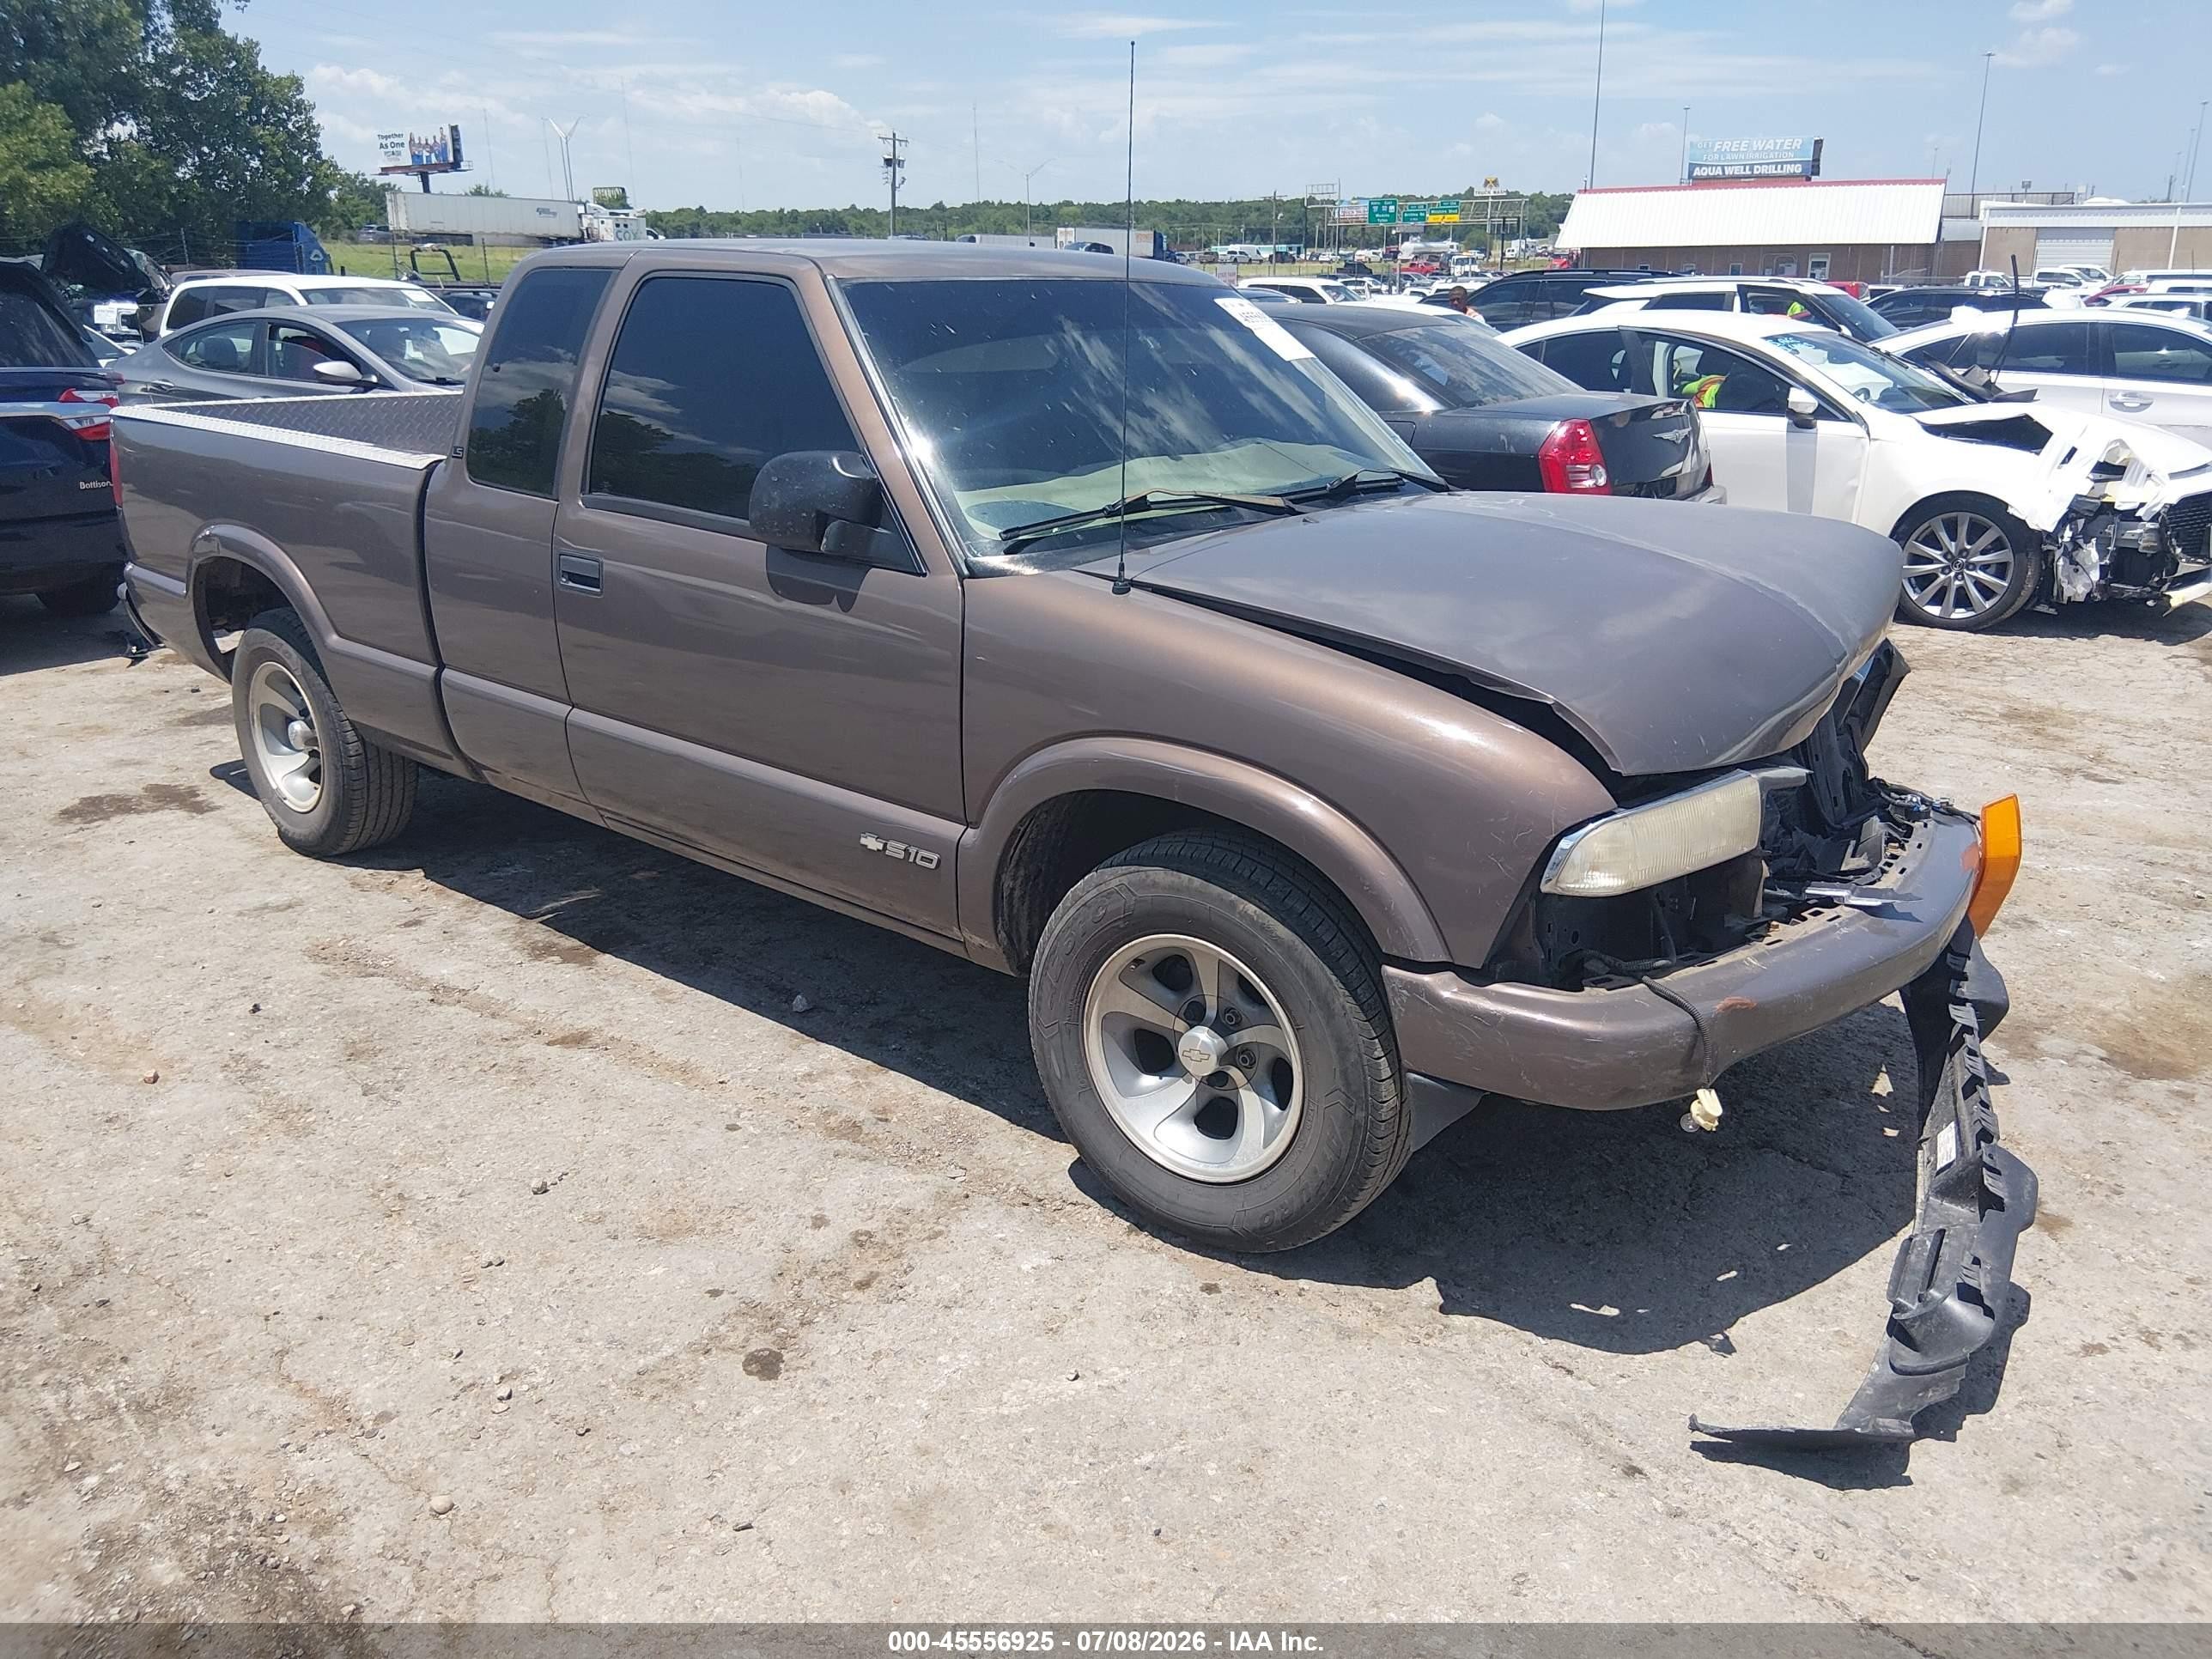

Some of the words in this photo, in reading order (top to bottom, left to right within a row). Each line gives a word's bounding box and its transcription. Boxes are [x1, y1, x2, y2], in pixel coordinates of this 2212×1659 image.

[377, 132, 404, 141] Together
[1713, 140, 1749, 152] FREE
[1753, 138, 1802, 150] WATER
[1720, 153, 1745, 161] LAWN
[1746, 151, 1795, 160] IRRIGATION
[1692, 166, 1723, 177] AQUA
[1724, 165, 1752, 176] WELL
[1753, 163, 1802, 175] DRILLING
[885, 840, 941, 870] S10
